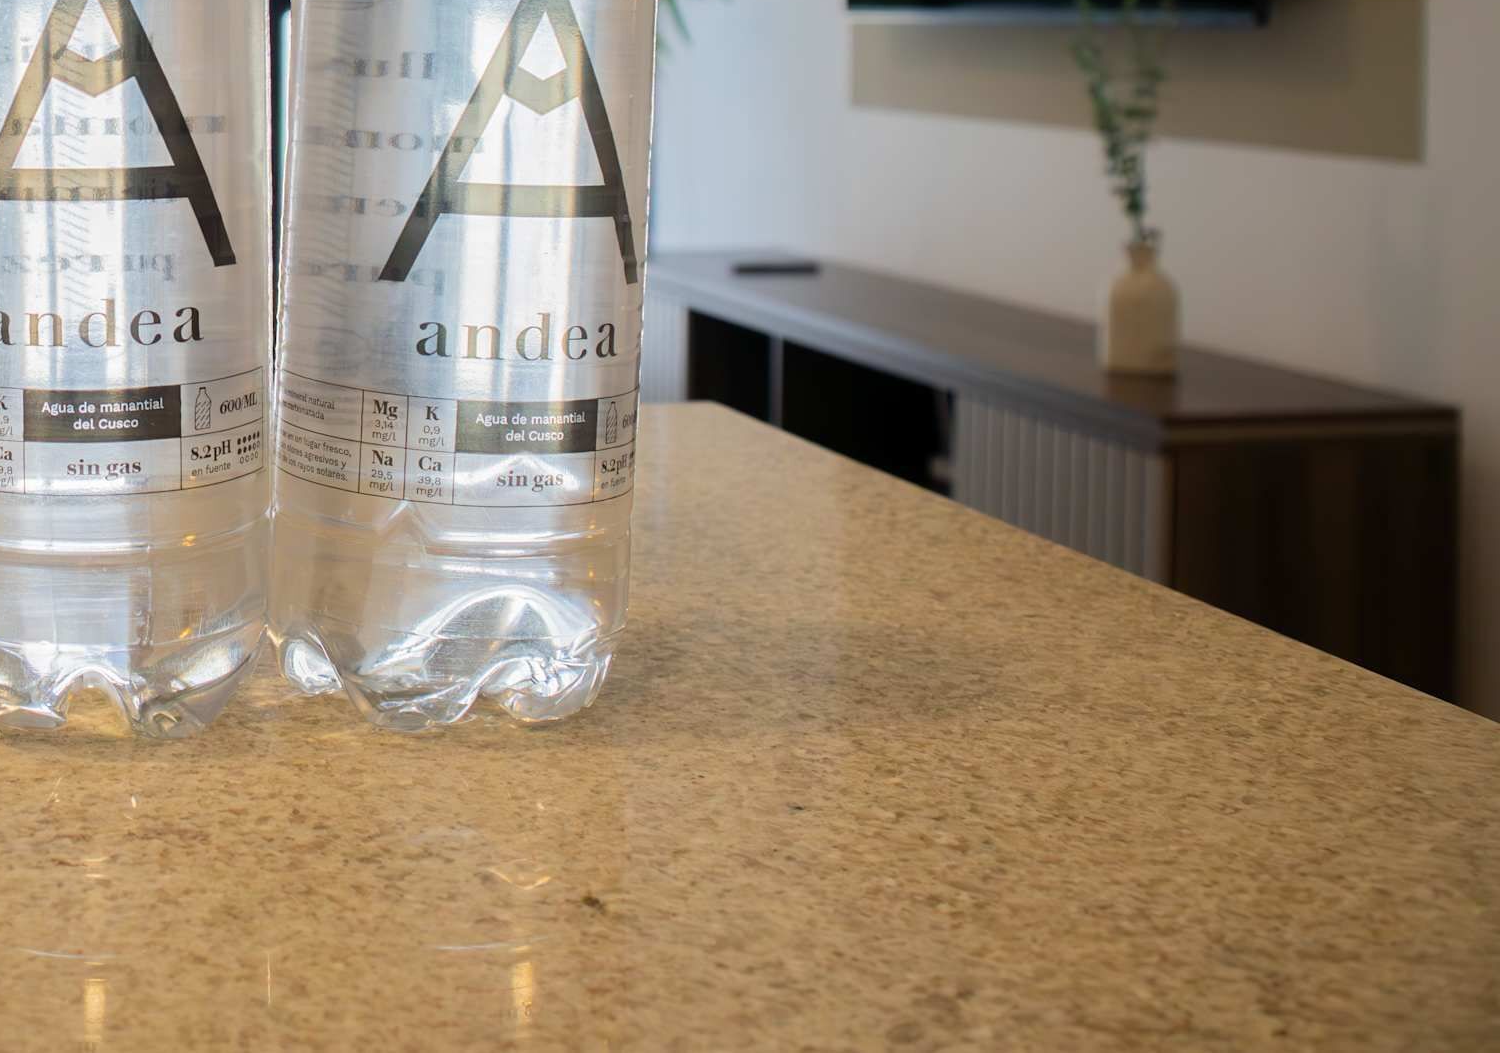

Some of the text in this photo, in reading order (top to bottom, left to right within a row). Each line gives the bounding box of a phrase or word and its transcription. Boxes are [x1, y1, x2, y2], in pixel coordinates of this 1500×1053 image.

[415, 312, 618, 362] andea
[41, 397, 164, 417] Agua de manantial
[372, 399, 399, 421] Mg
[424, 405, 441, 421] K
[73, 417, 139, 430] del Cusco
[374, 419, 394, 430] 3,14
[475, 411, 586, 426] Agua de manantial
[371, 430, 397, 442] mg/l
[423, 425, 441, 436] 0,9
[505, 429, 565, 442] del Cusco
[322, 442, 352, 457] fresco,
[418, 436, 445, 448] mg/l
[341, 460, 347, 470] y
[371, 449, 394, 467] Na
[417, 455, 443, 472] Ca
[66, 458, 143, 482] sin gas
[191, 462, 232, 477] en fuente
[316, 467, 348, 482] solares.
[371, 468, 393, 481] 29,5
[369, 481, 395, 492] mg/l
[417, 476, 442, 487] 39,8
[496, 469, 565, 493] sin gas
[415, 487, 443, 498] mg/l
